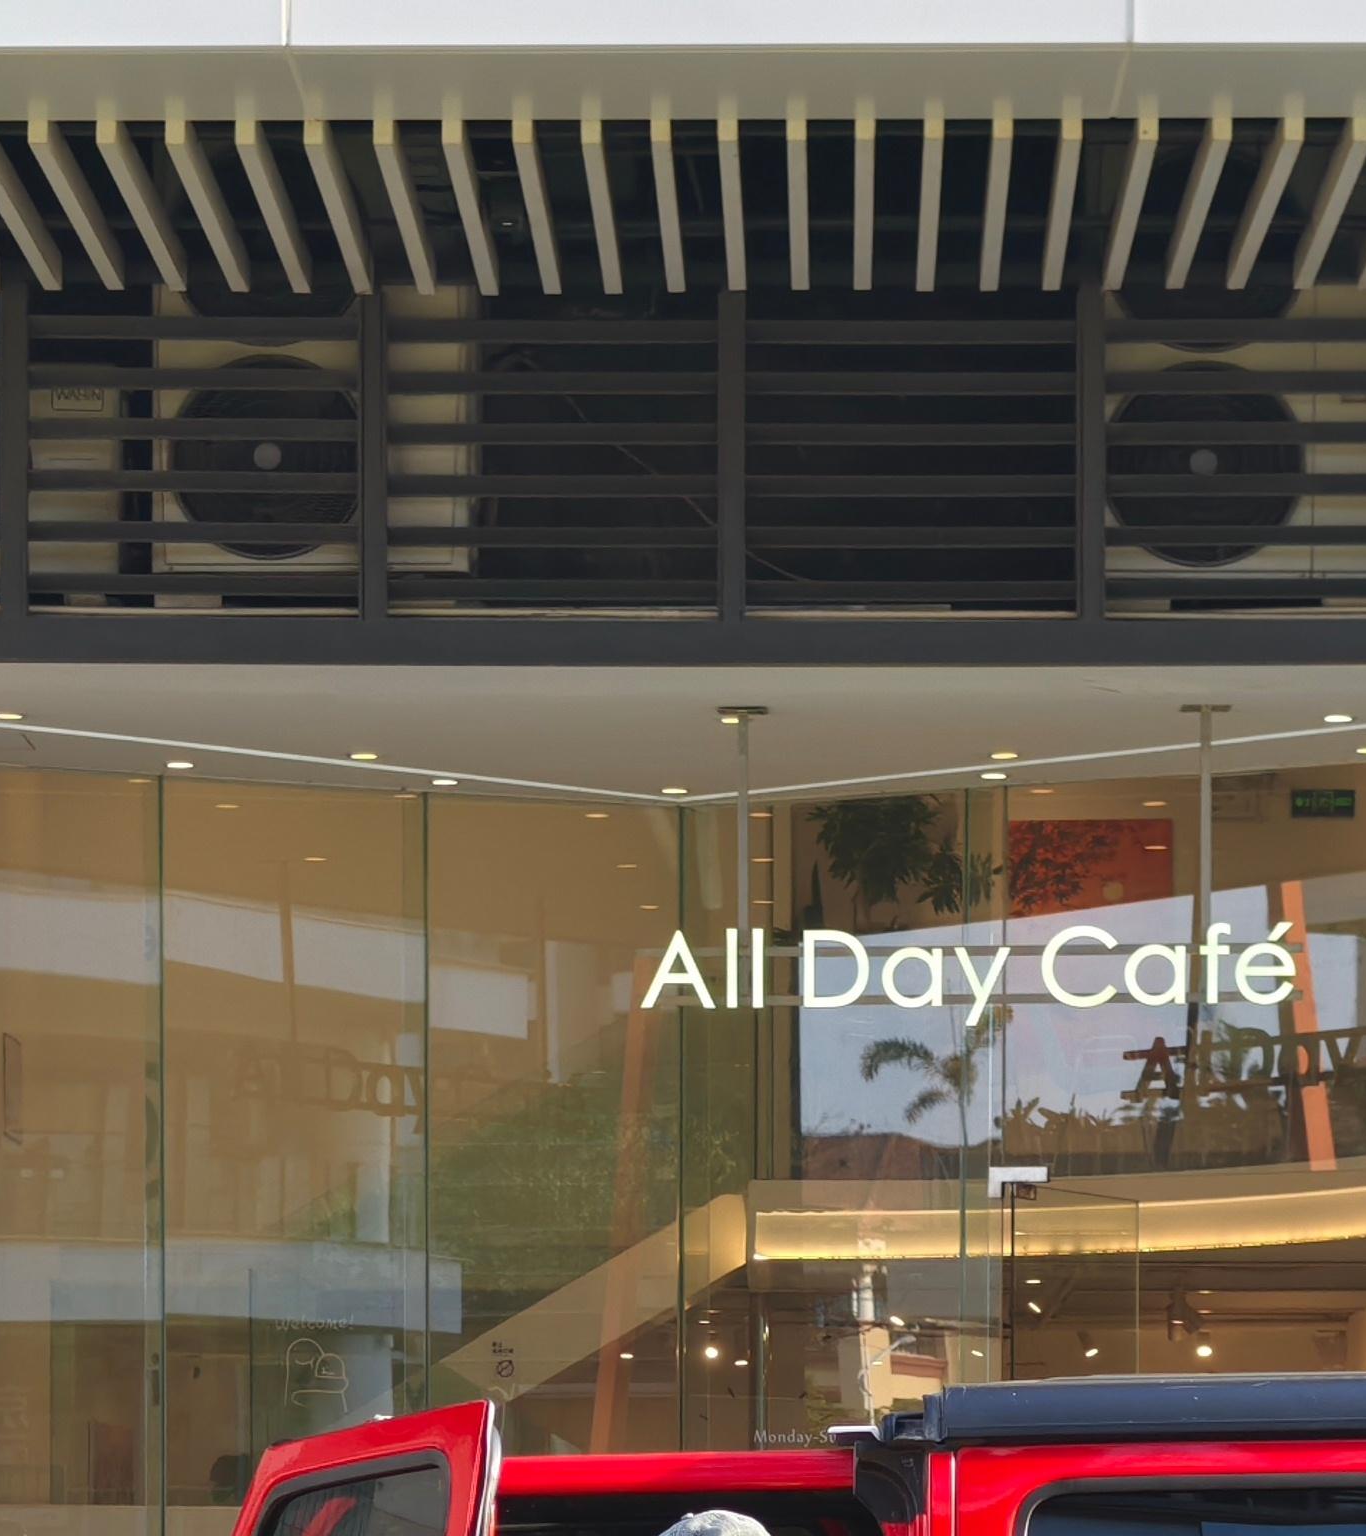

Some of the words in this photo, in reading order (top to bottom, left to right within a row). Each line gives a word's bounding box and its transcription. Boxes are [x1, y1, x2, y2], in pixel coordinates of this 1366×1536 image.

[640, 928, 765, 1010] All
[801, 929, 1011, 1026] Day
[1040, 921, 1297, 1009] Café
